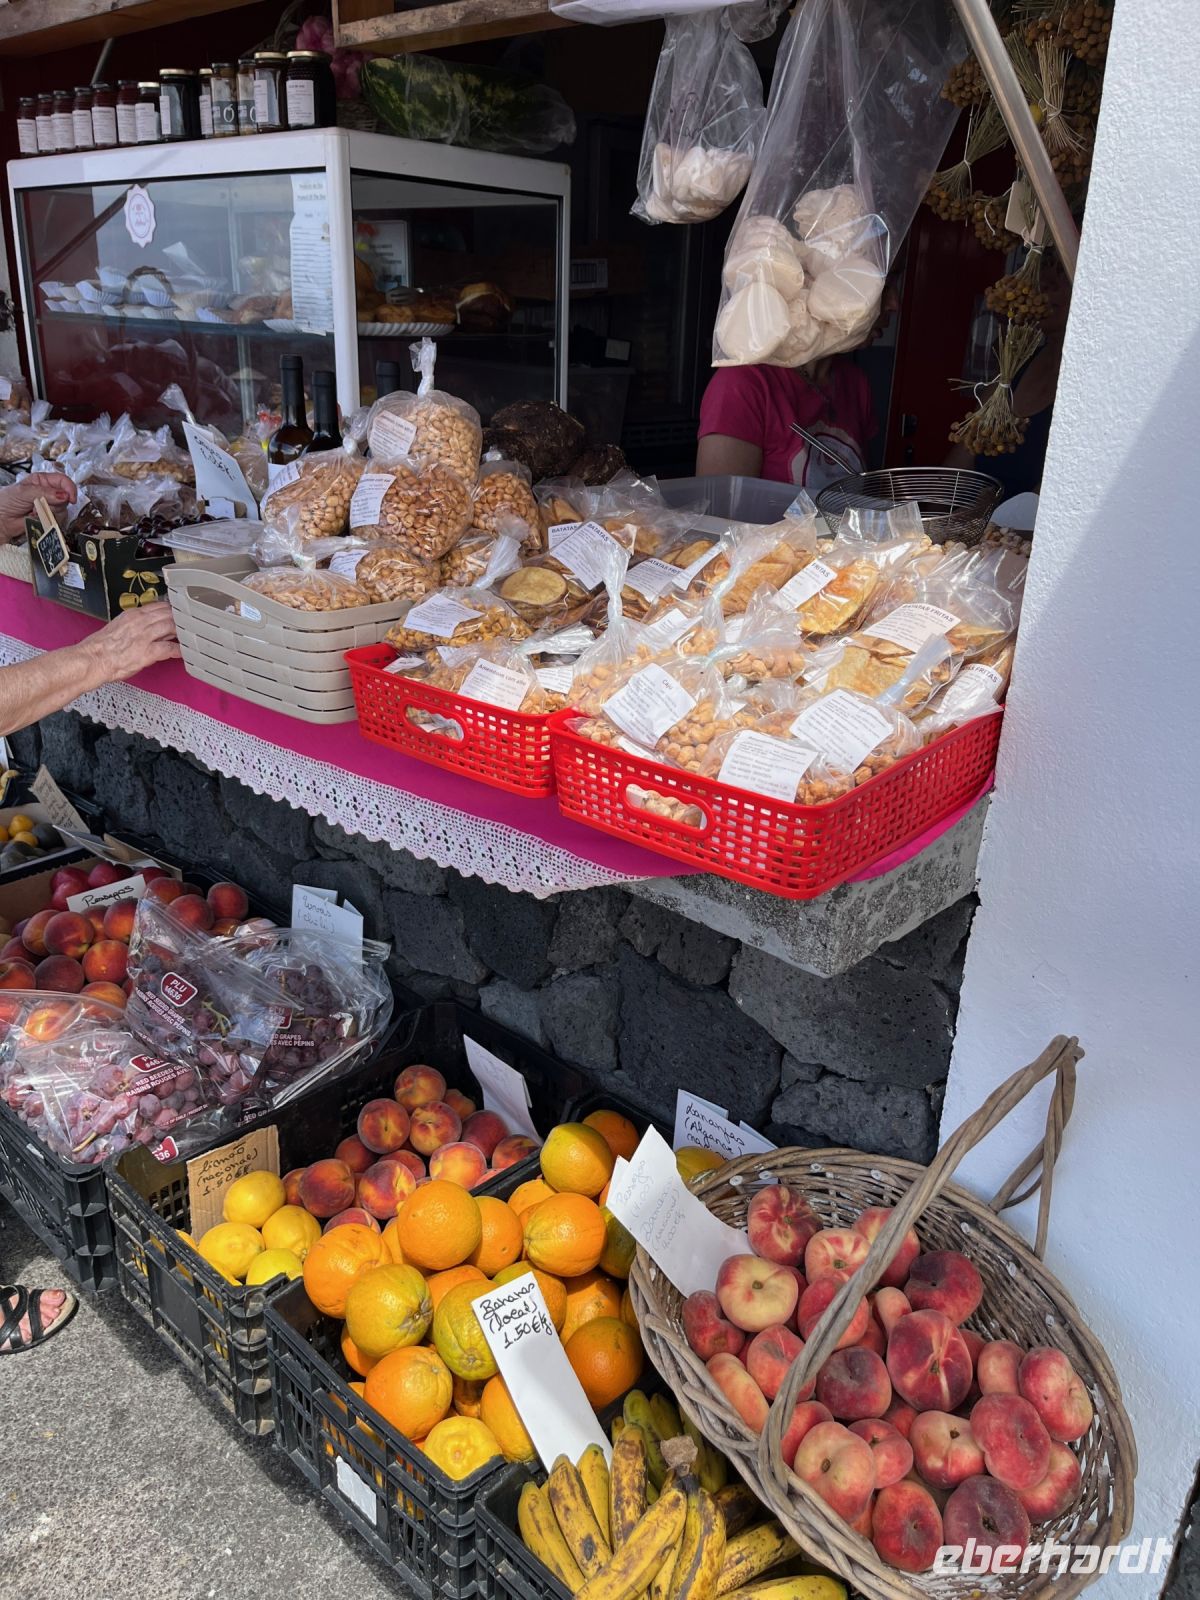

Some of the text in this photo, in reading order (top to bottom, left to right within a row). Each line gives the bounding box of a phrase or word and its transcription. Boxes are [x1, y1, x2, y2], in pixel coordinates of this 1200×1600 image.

[587, 523, 609, 542] BATATAS
[649, 559, 668, 571] ATATAS
[170, 979, 188, 992] PLU
[145, 990, 185, 1024] RED SEEDED GRAPES
[146, 999, 165, 1016] ROUGES
[162, 1012, 175, 1025] AVEC
[126, 1081, 151, 1097] RAISINS
[151, 1073, 177, 1087] ROUGES
[136, 1068, 174, 1087] RED SEEDED
[480, 1282, 536, 1320] Bananas
[488, 1296, 538, 1335] (local)
